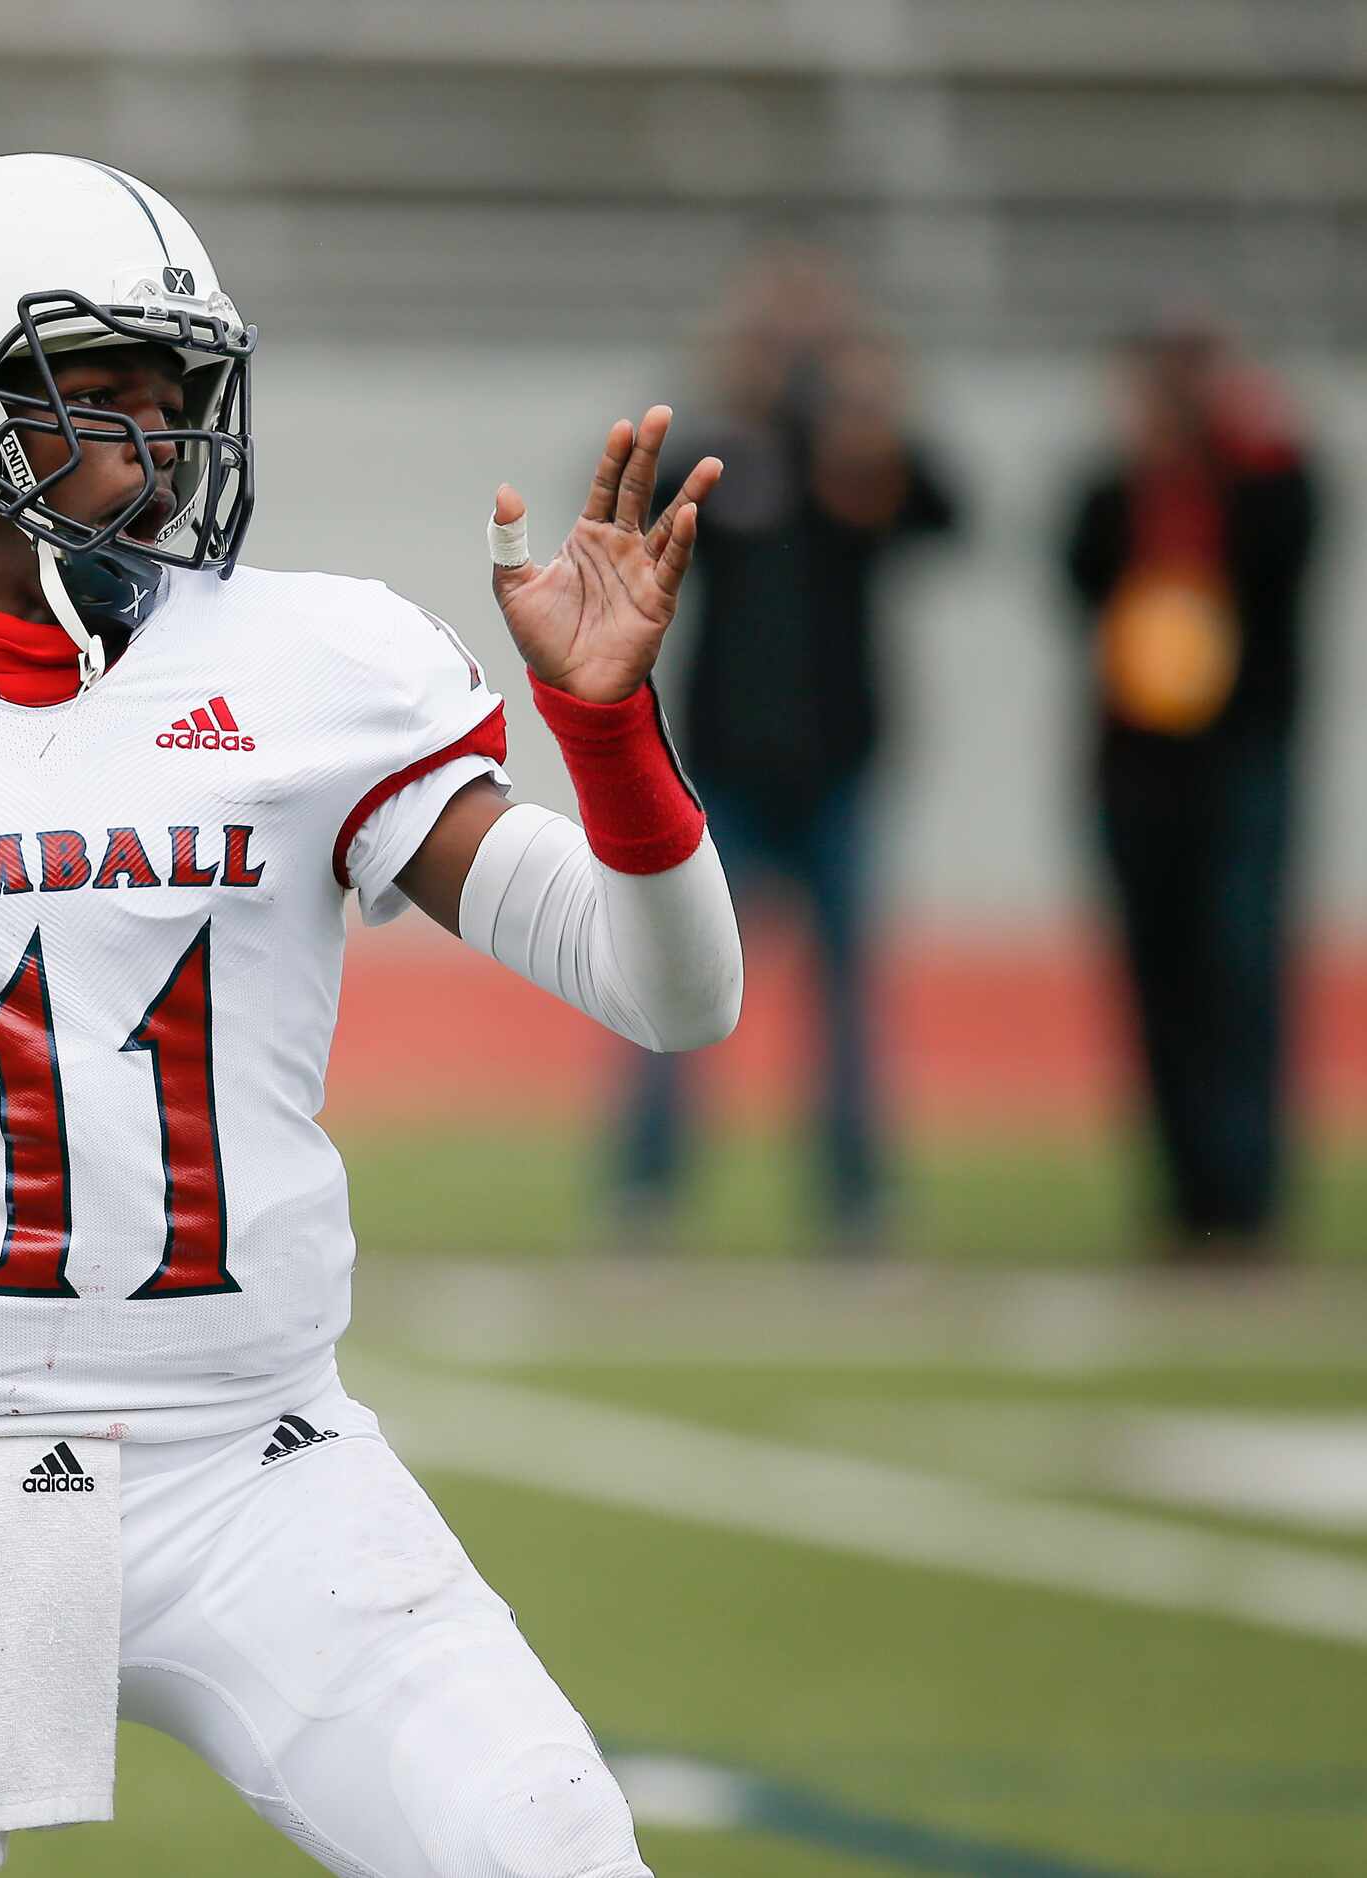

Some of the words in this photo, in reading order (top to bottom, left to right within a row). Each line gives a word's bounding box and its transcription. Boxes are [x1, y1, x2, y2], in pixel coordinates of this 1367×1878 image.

[155, 500, 195, 544] XENITH
[155, 729, 256, 752] adidas
[261, 1430, 340, 1466] adidas
[22, 1473, 95, 1493] adidas
